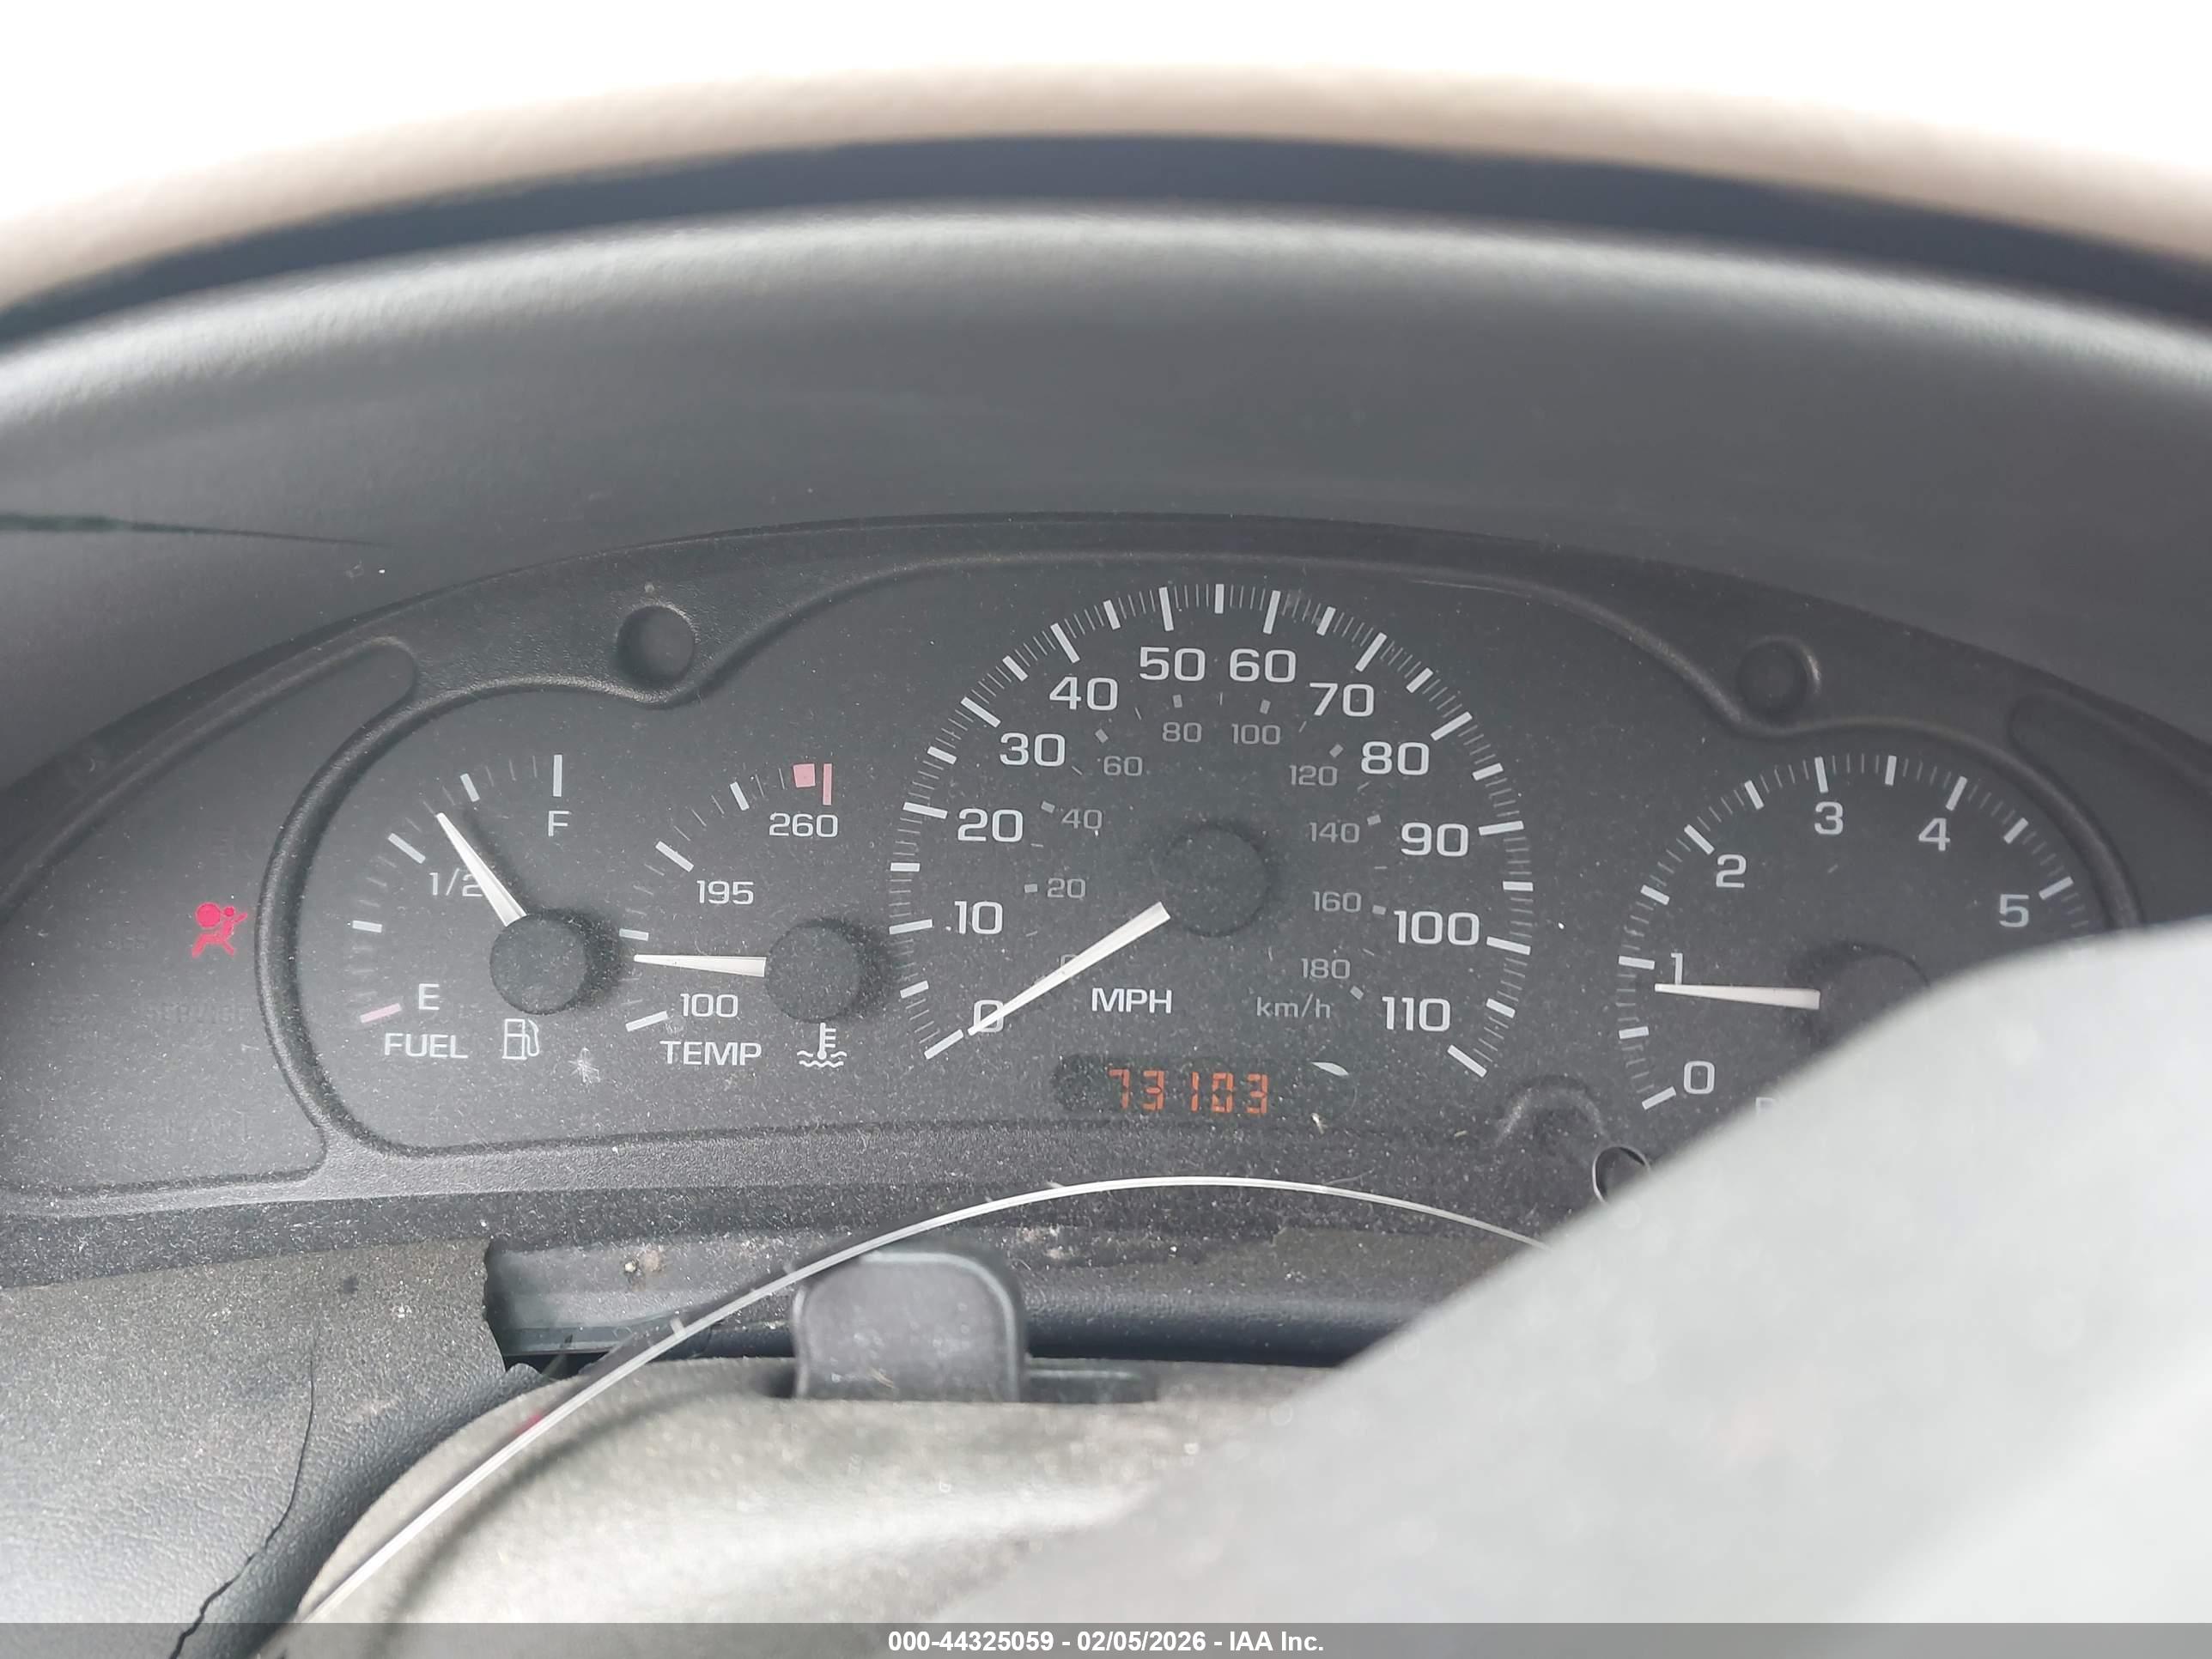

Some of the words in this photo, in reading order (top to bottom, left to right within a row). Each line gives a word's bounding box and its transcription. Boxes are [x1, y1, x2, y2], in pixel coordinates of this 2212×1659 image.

[1140, 647, 1205, 681] 50
[1230, 649, 1296, 682] 60
[1050, 677, 1117, 710] 40
[1310, 683, 1374, 716] 70
[1163, 722, 1201, 742] 80
[1232, 724, 1280, 744] 100
[1000, 733, 1065, 766] 30
[1362, 742, 1429, 775] 80
[1104, 756, 1142, 776] 60
[1290, 765, 1337, 786] 120
[549, 811, 569, 836] F
[769, 812, 837, 837] 260
[958, 809, 1023, 842] 20
[1062, 809, 1103, 829] 40
[1310, 823, 1359, 842] 140
[1814, 802, 1843, 835] 3
[1401, 823, 1468, 856] 90
[1918, 818, 1950, 851] 4
[428, 867, 484, 897] 1/2
[1717, 854, 1746, 888] 2
[697, 880, 753, 904] 195
[1048, 878, 1085, 900] 20
[1313, 891, 1361, 913] 160
[955, 902, 1002, 934] 10
[2000, 894, 2028, 927] 5
[1395, 911, 1479, 945] 100
[1302, 958, 1350, 979] 180
[1670, 952, 1684, 985] 1
[419, 983, 440, 1010] E
[680, 994, 738, 1018] 100
[1092, 988, 1171, 1013] MPH
[1257, 994, 1330, 1018] km/h
[973, 1000, 1005, 1033] 0
[1382, 997, 1450, 1031] 110
[385, 1033, 468, 1059] FUEL
[659, 1041, 762, 1065] TEMP
[1109, 1069, 1268, 1114] 73103
[1684, 1061, 1715, 1094] 0
